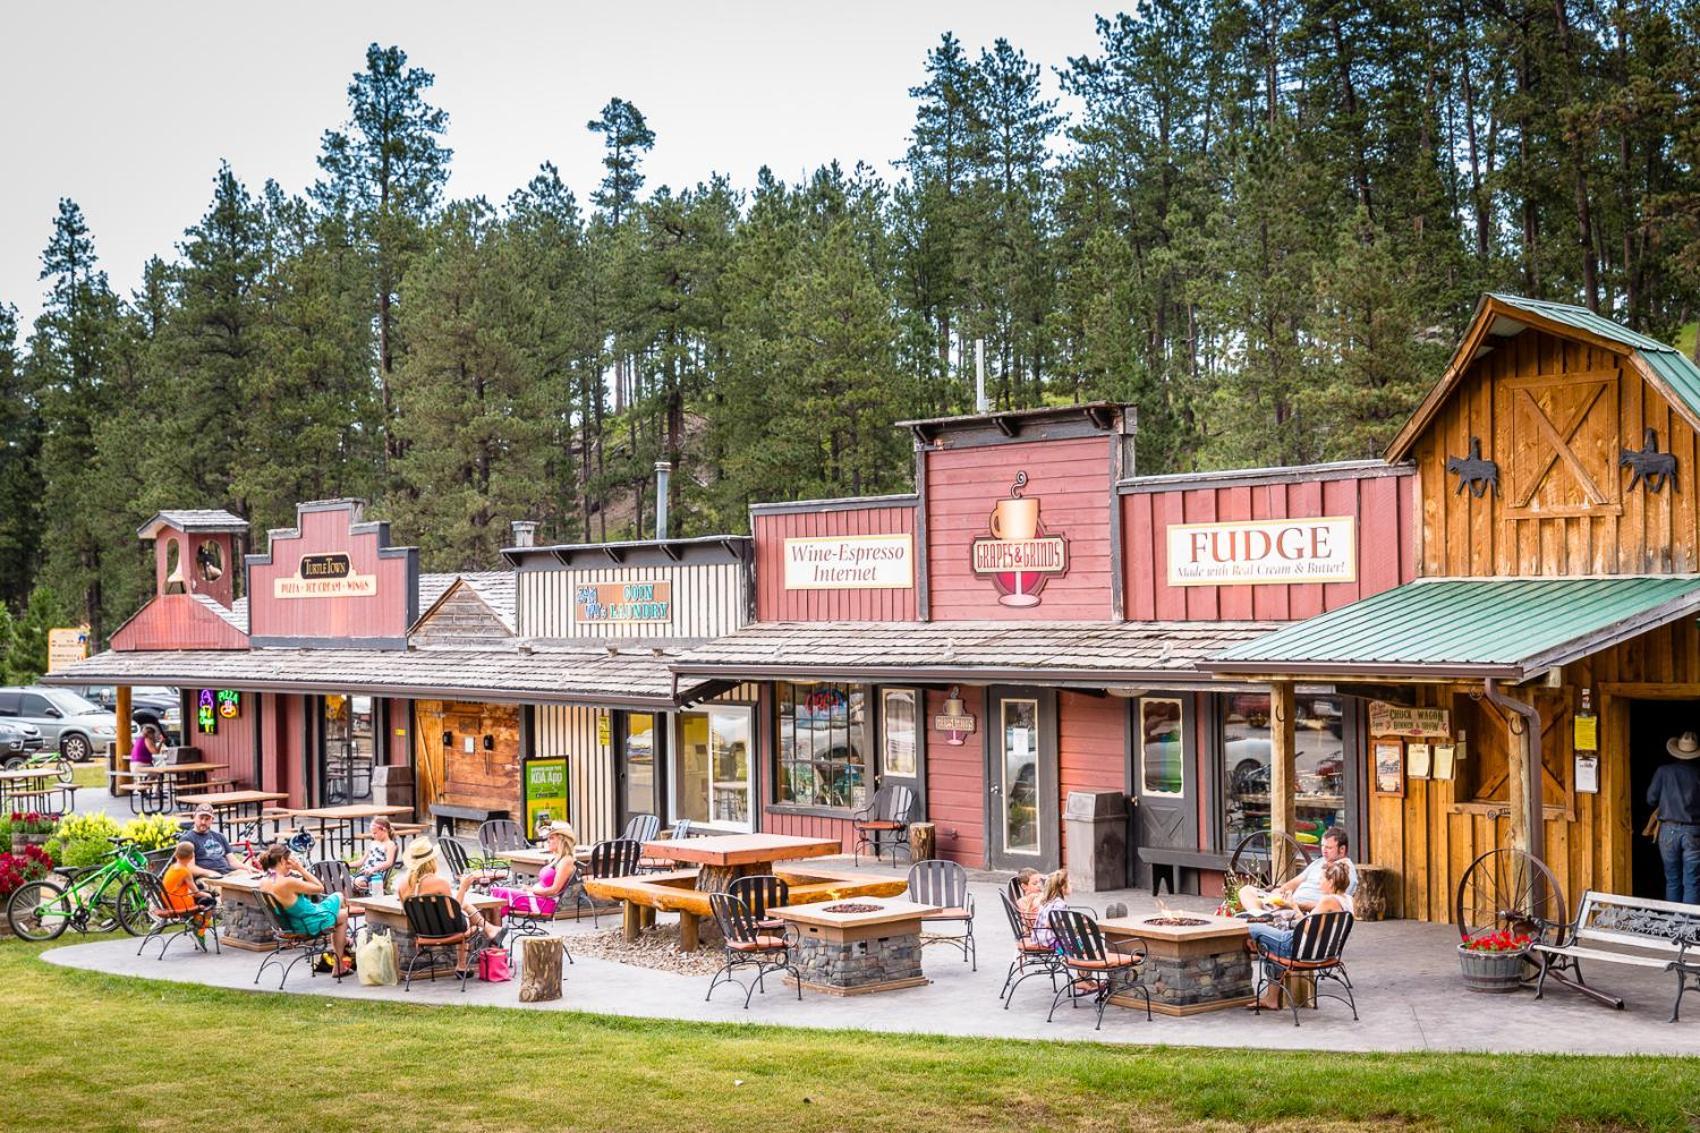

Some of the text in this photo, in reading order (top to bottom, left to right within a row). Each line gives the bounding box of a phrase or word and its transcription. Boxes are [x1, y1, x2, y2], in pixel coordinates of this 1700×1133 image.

[1190, 526, 1332, 563] FUDGE
[791, 543, 905, 566] Wine-Espresso
[977, 541, 1060, 568] GRAPES & GRINDS
[813, 565, 877, 582] Internet
[1178, 561, 1346, 578] Made with Real Cream & Butter!
[624, 585, 654, 601] COIN
[610, 603, 668, 619] LAUNDRY
[219, 690, 238, 704] PIZZA
[1390, 709, 1412, 719] CHUCK
